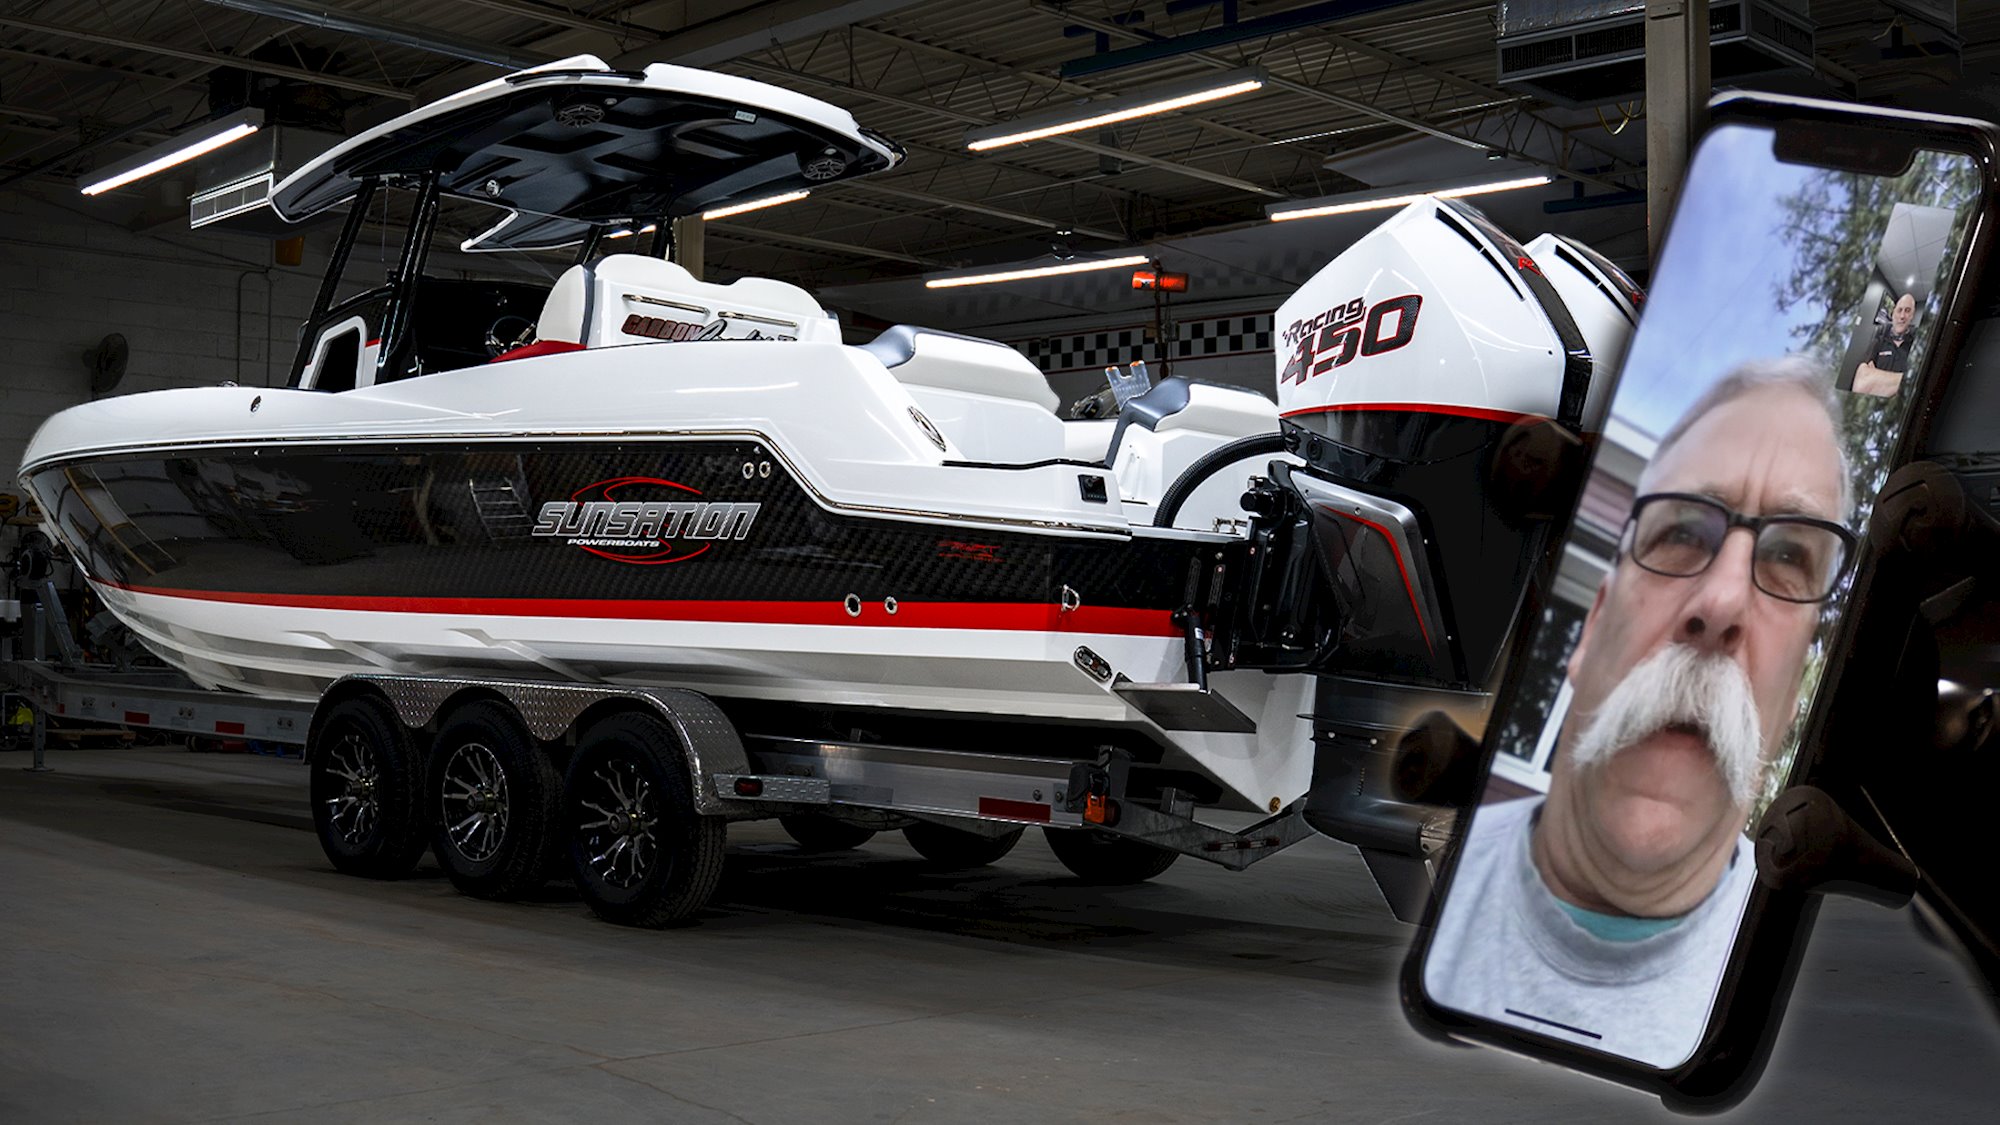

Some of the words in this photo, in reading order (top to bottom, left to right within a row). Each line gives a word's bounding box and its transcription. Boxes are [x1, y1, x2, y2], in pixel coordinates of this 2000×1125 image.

[621, 314, 704, 342] CARBON
[1280, 294, 1424, 386] 450
[1285, 296, 1365, 347] Racing
[531, 501, 762, 541] SUNSATION
[567, 538, 661, 548] POWERBOATS
